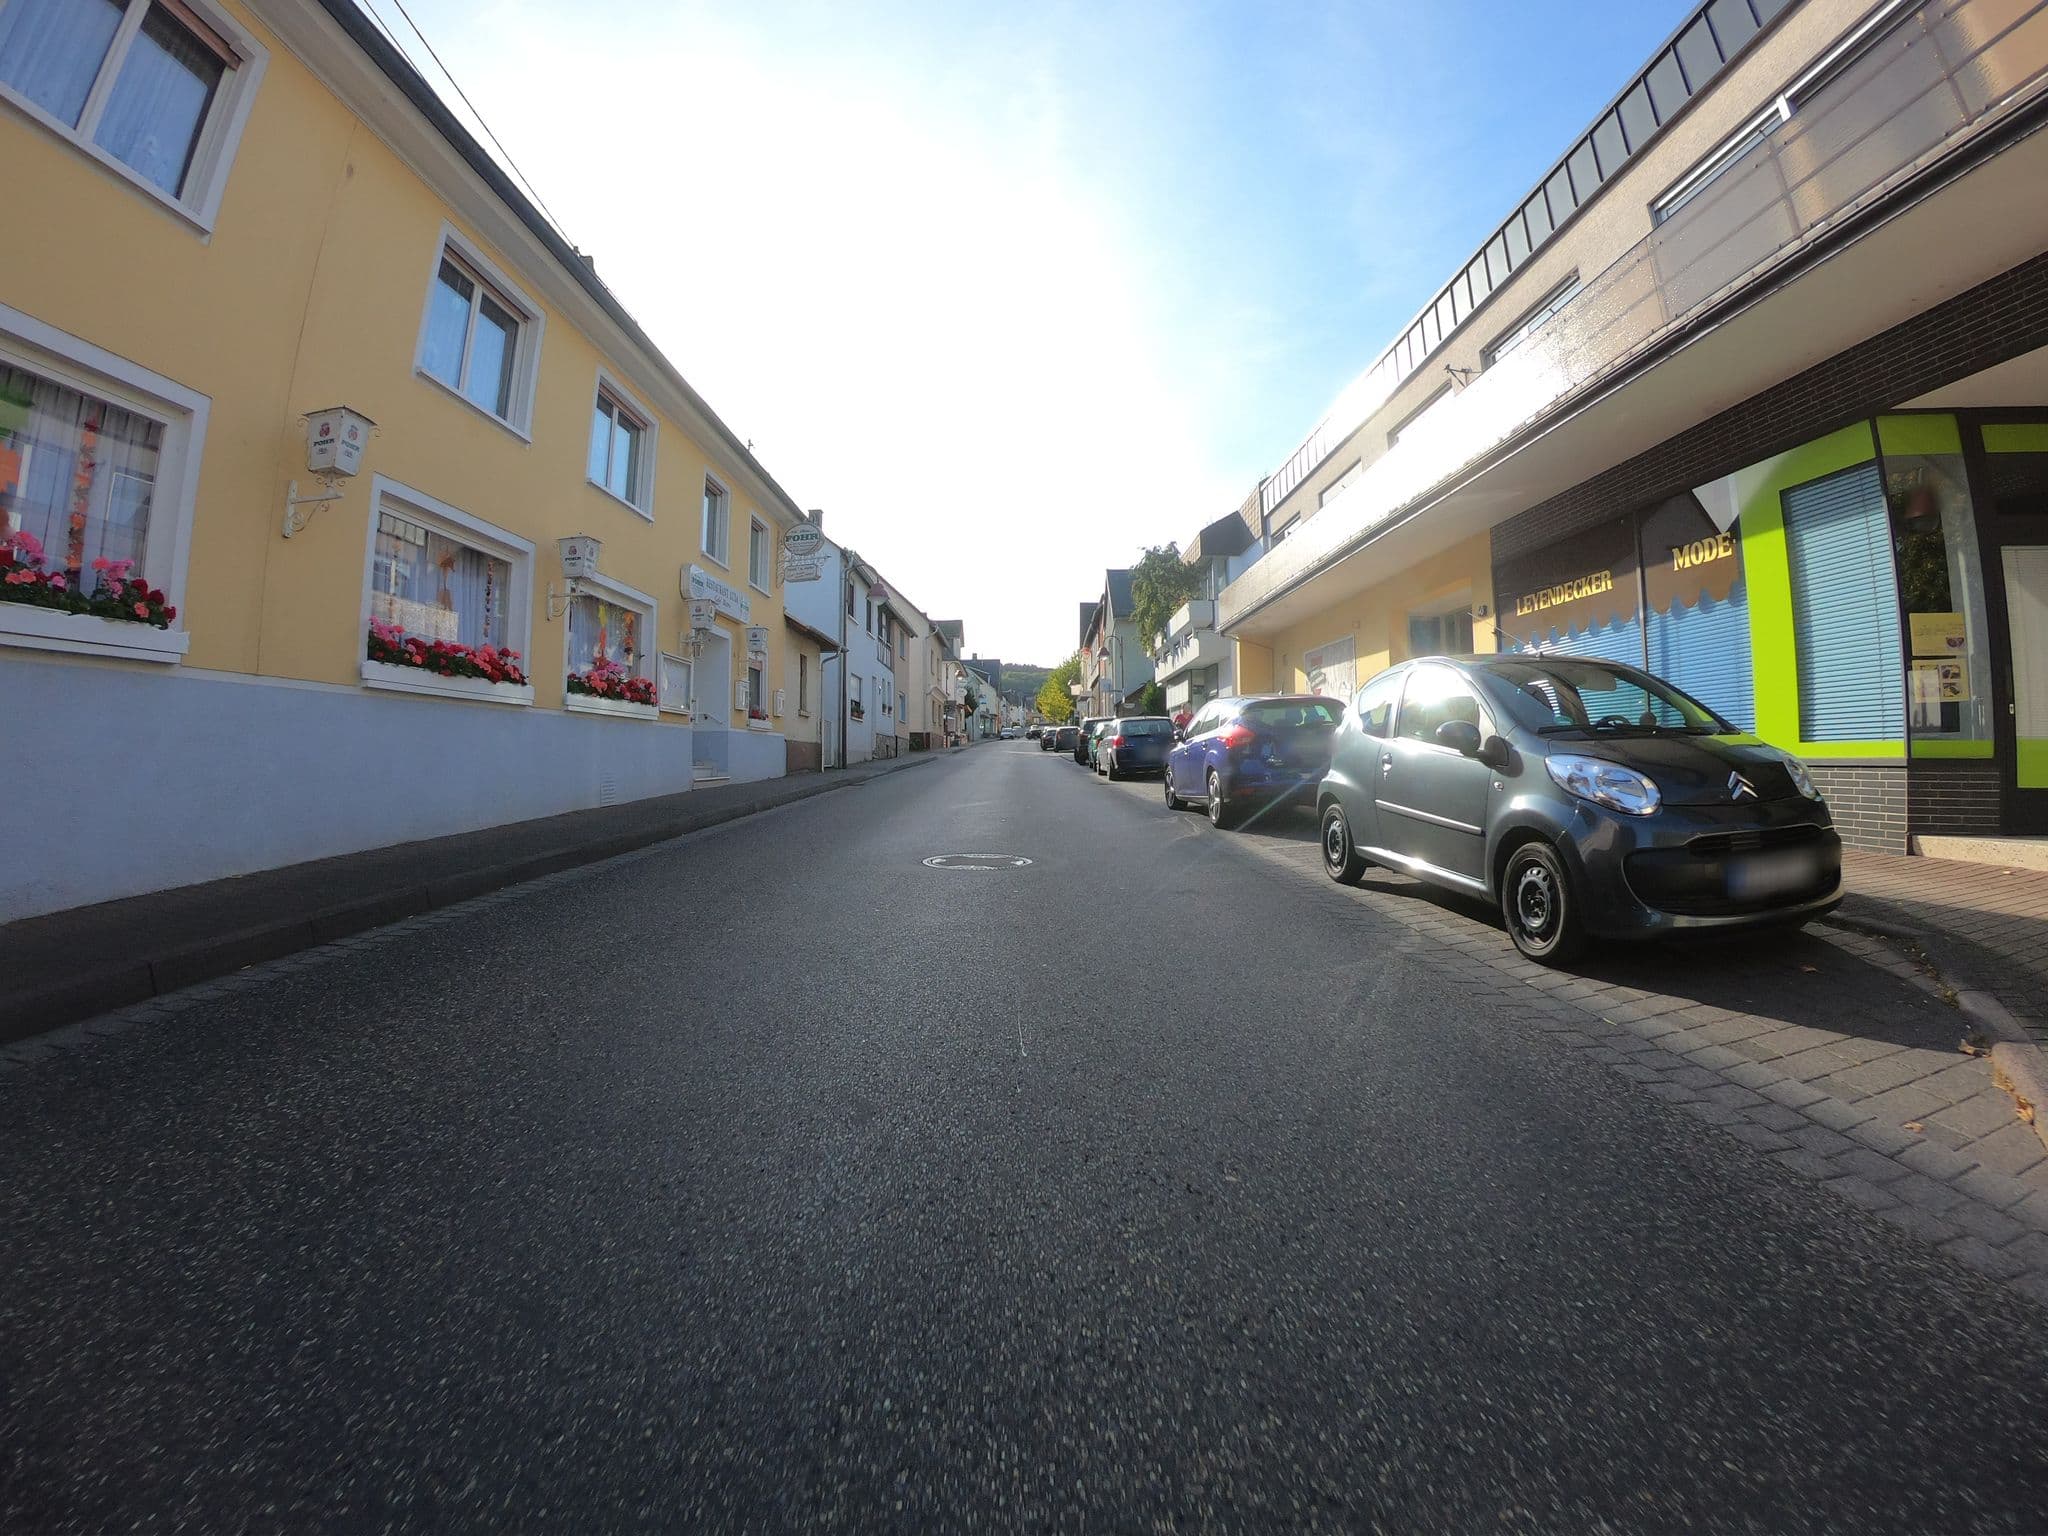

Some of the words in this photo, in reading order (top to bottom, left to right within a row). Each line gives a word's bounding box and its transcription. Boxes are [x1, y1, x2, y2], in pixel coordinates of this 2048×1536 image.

[785, 533, 819, 542] FOHR
[1672, 531, 1734, 571] MODE
[1515, 570, 1614, 616] LEYENDECKER
